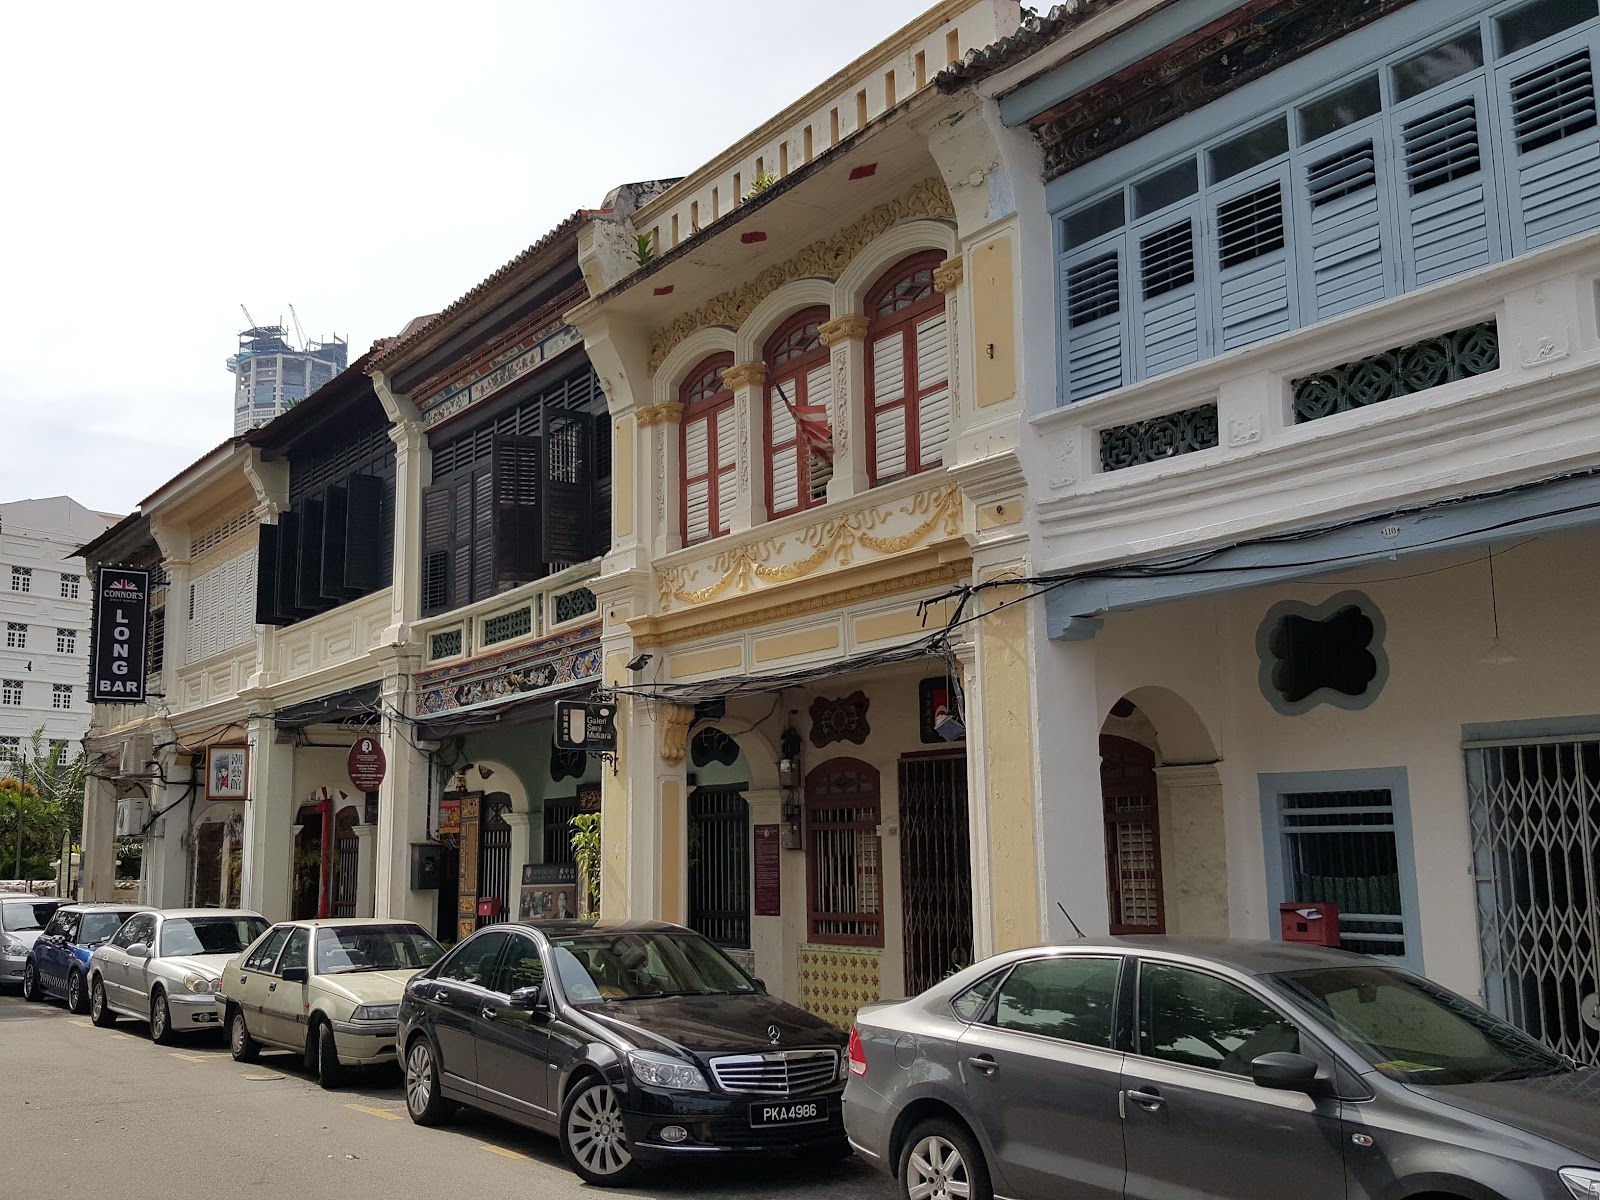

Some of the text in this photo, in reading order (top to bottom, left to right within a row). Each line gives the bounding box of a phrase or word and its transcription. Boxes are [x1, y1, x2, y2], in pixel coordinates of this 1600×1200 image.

[104, 589, 143, 600] CONNOR'S
[112, 609, 130, 675] LONG
[99, 680, 138, 693] BAR
[587, 716, 607, 725] Galeri
[763, 1104, 817, 1121] PKA4986
